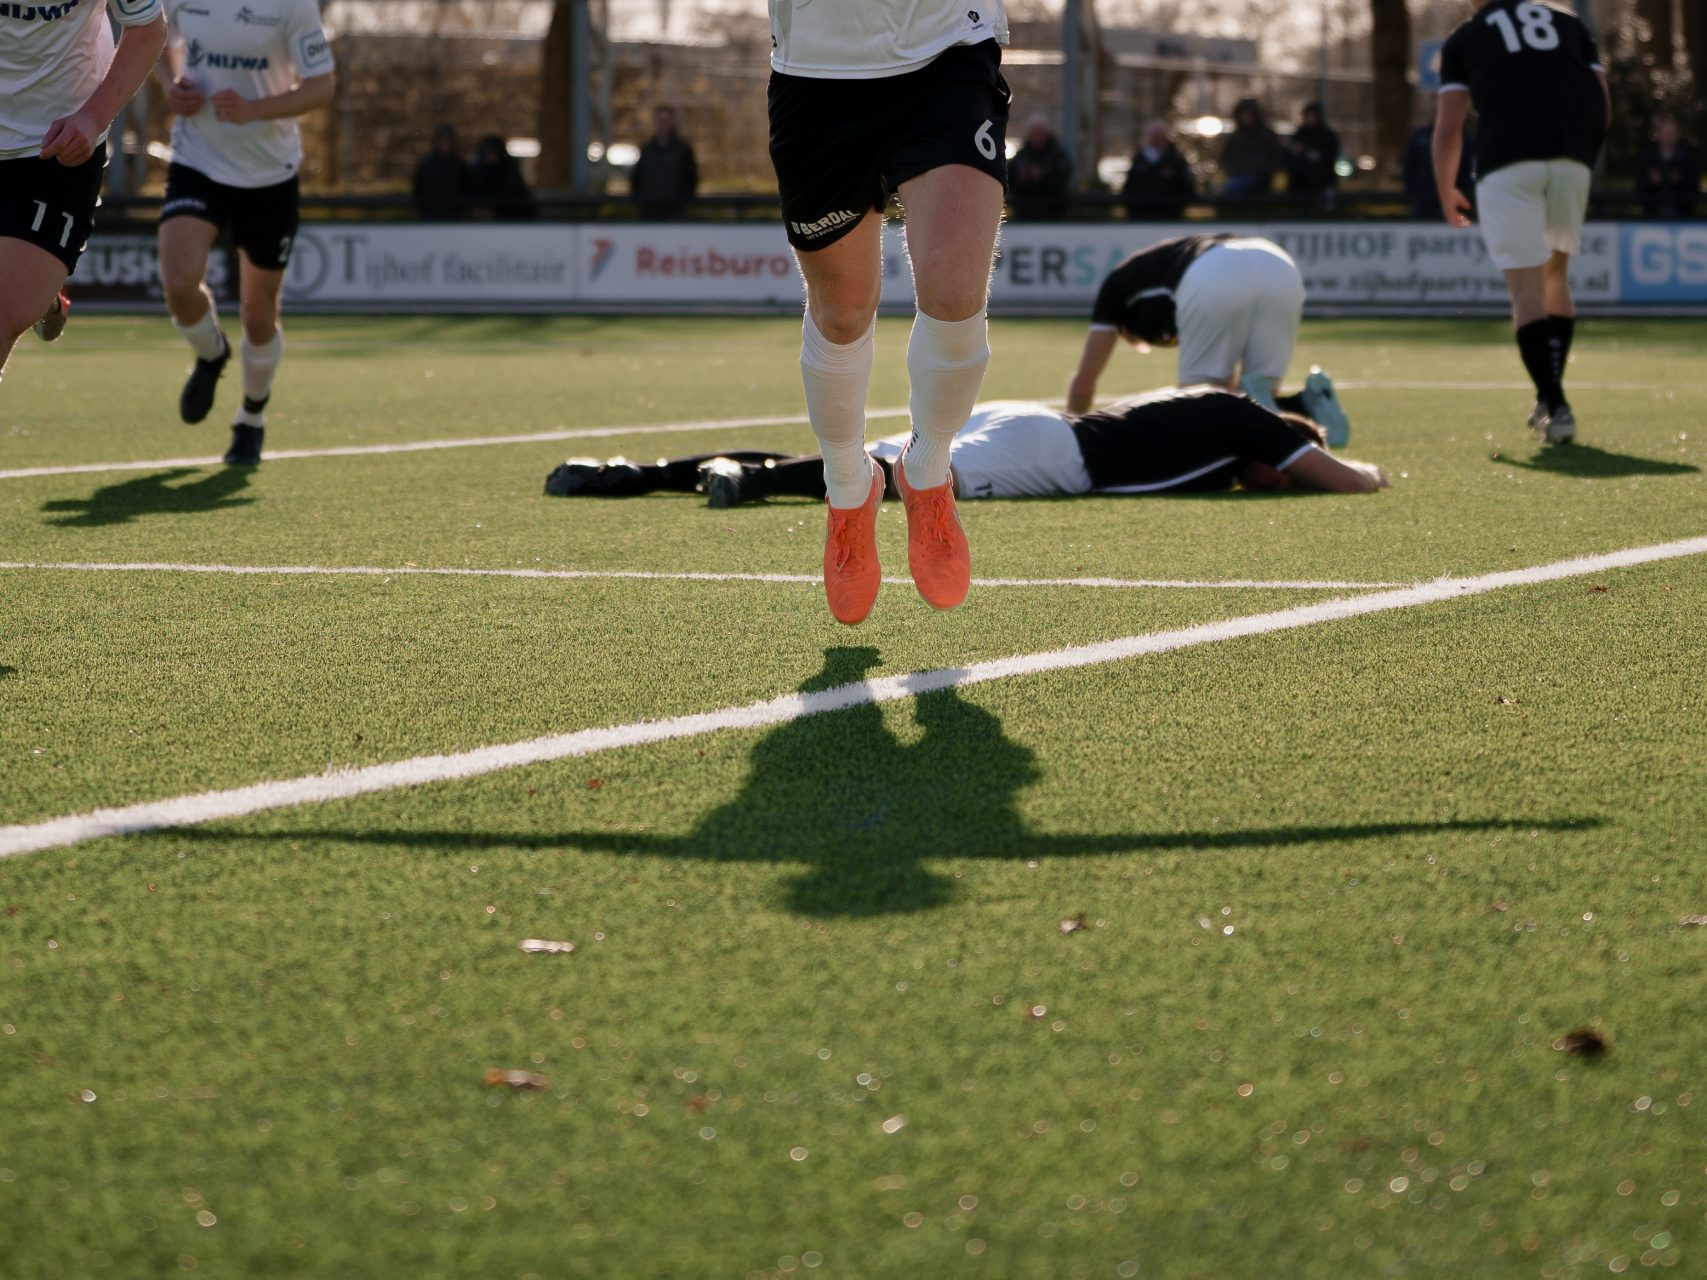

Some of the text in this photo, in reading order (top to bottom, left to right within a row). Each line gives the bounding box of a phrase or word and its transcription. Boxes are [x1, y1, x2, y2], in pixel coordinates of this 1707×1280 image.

[1486, 1, 1560, 53] 18
[207, 52, 269, 70] NIJWA
[975, 120, 996, 160] 6
[30, 200, 73, 248] 11
[331, 235, 566, 287] Tijhof facilitair
[635, 246, 790, 278] Reisburo
